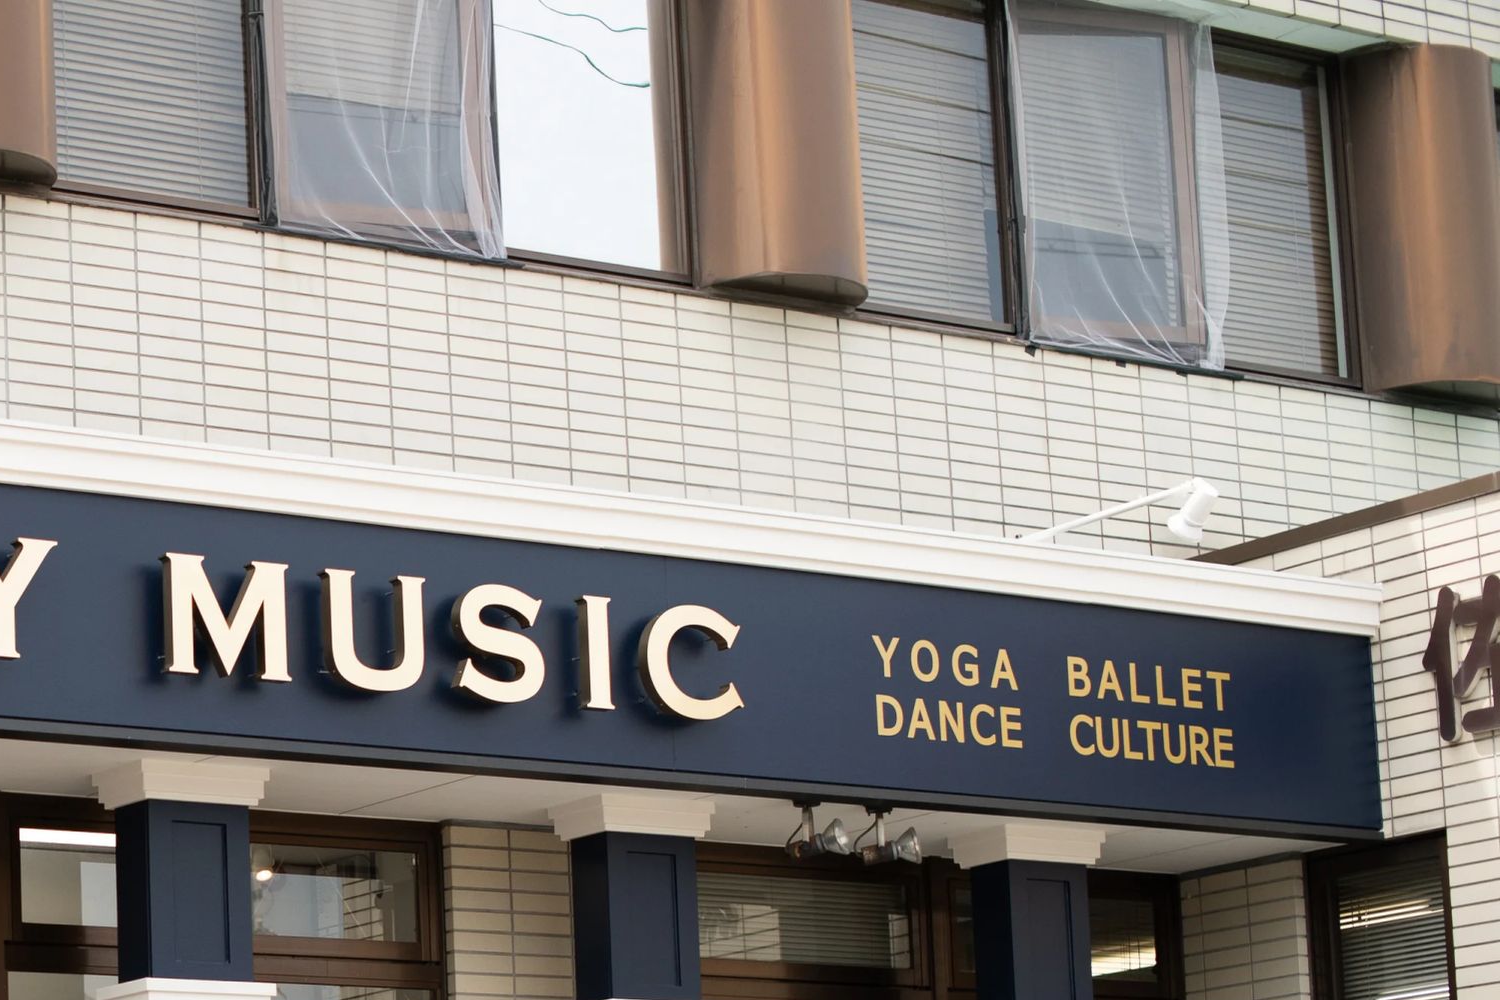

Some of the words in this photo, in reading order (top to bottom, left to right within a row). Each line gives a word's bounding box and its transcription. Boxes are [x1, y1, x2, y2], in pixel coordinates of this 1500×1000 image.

[160, 552, 744, 721] MUSIC
[871, 635, 1019, 691] YOGA
[1067, 656, 1231, 711] BALLET
[875, 694, 1023, 749] DANCE
[1069, 714, 1235, 769] CULTURE
